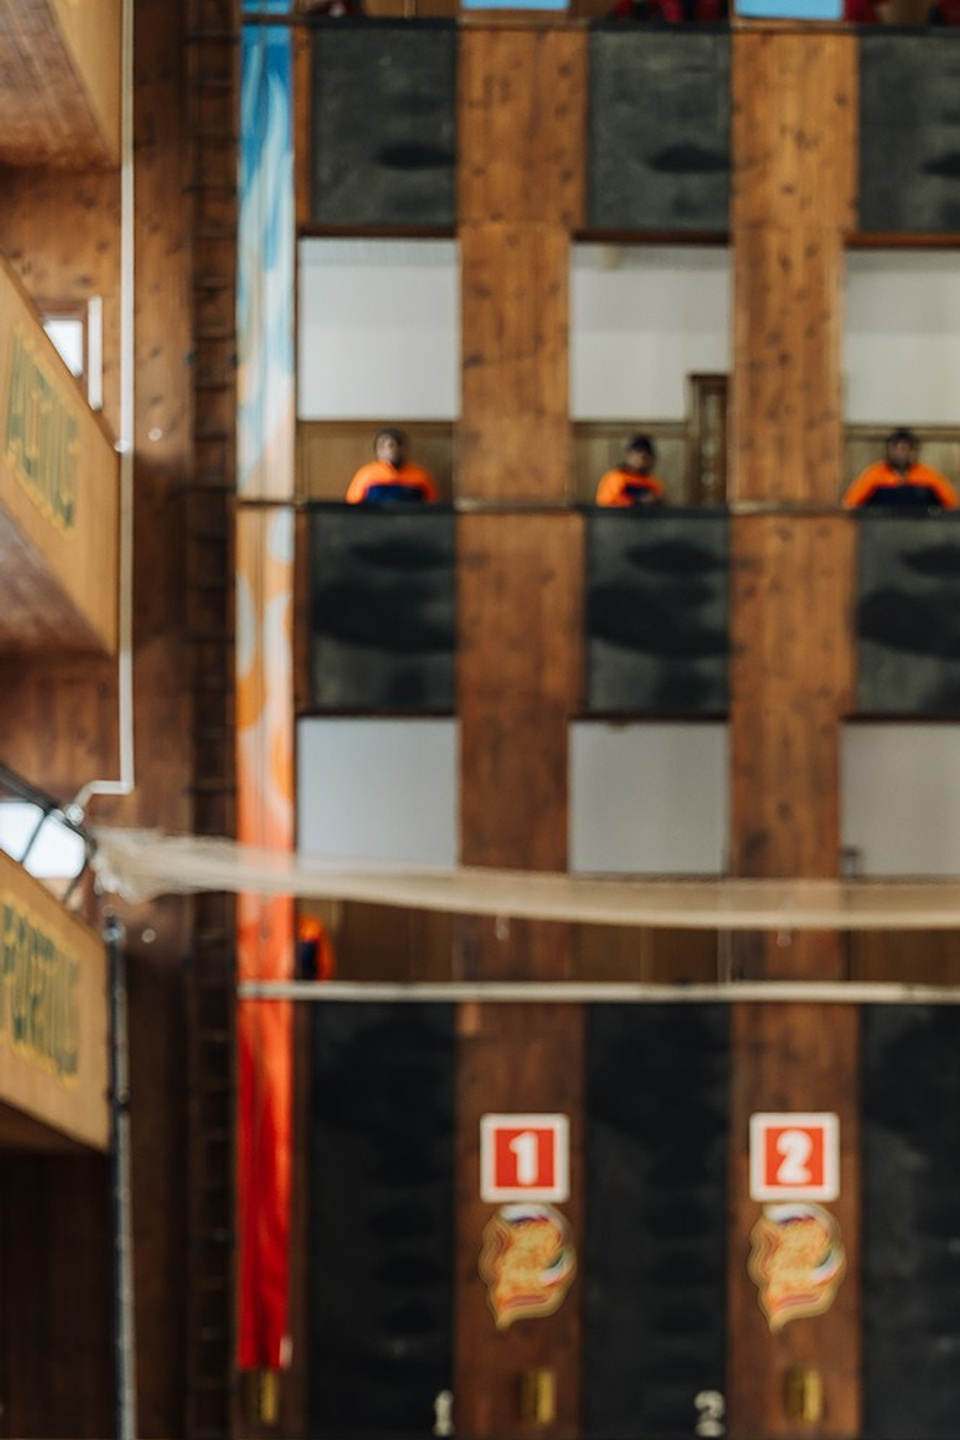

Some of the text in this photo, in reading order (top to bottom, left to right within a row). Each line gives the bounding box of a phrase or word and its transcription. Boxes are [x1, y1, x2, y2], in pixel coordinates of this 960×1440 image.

[509, 1131, 538, 1186] 1
[775, 1129, 813, 1185] 2
[434, 1388, 455, 1437] 1
[695, 1390, 725, 1438] 2
